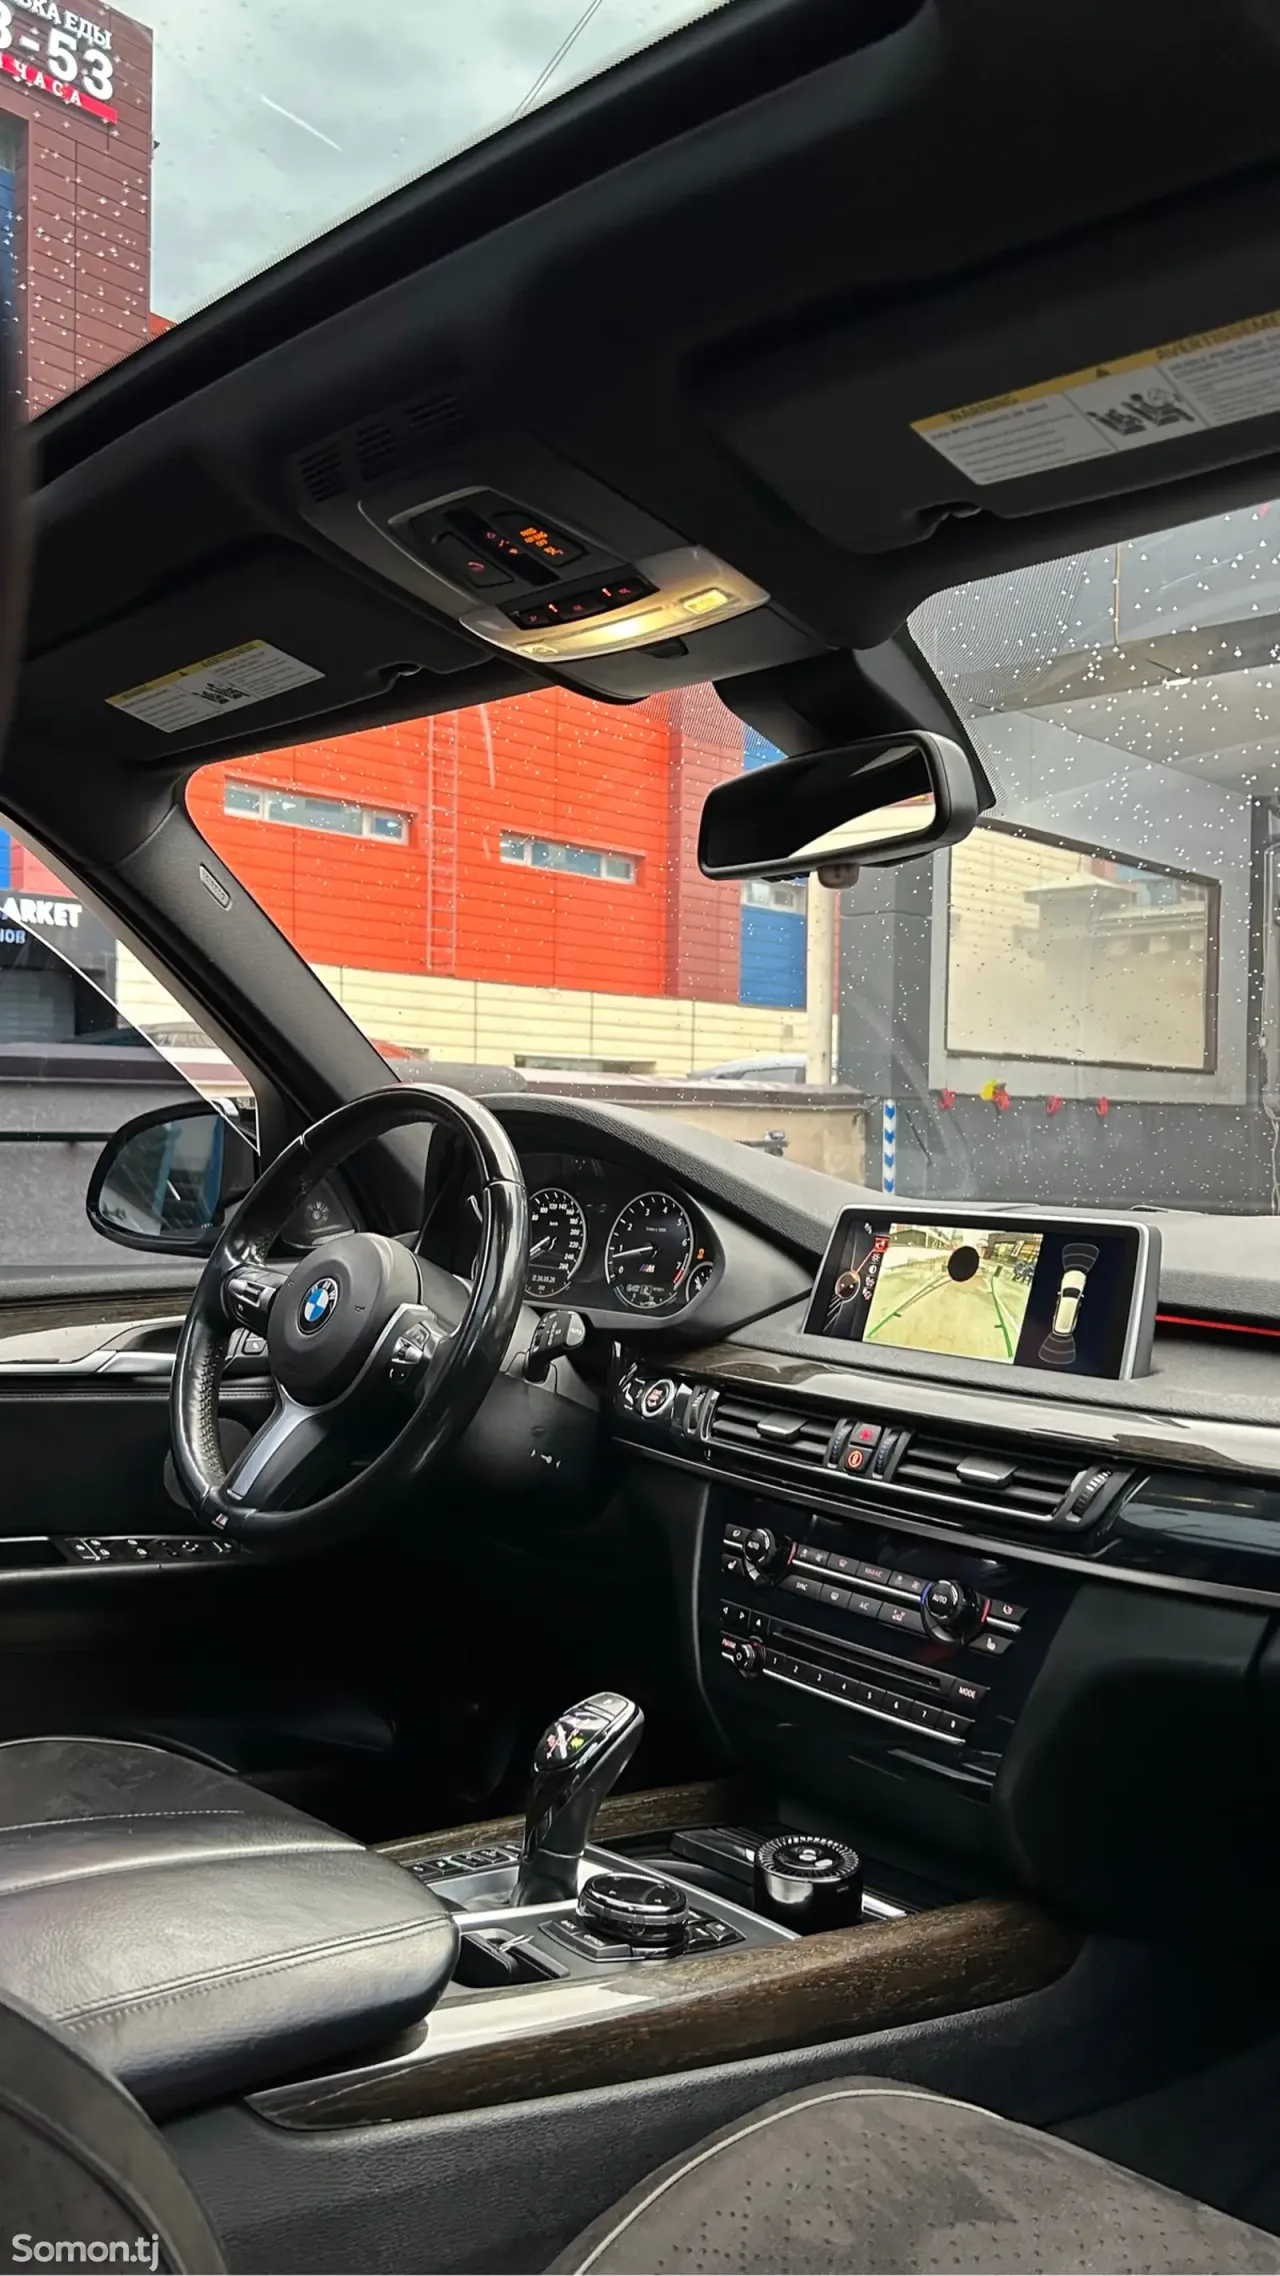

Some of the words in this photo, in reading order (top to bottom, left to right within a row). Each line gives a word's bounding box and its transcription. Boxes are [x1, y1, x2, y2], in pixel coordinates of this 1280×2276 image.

[64, 10, 113, 50] ЕДЫ
[13, 58, 82, 106] ЧАСА
[644, 1208, 651, 1217] 3
[662, 1206, 668, 1214] 4
[627, 1223, 634, 1231] 2
[676, 1218, 683, 1227] 5
[681, 1238, 688, 1247] 6
[676, 1261, 682, 1269] 7
[747, 1540, 760, 1550] AUTO
[932, 1593, 947, 1605] AUTO
[793, 1665, 799, 1673] 2
[817, 1673, 822, 1682] 3
[867, 1691, 872, 1699] 5
[958, 1686, 976, 1699] MODE
[894, 1701, 899, 1709] 6
[922, 1710, 927, 1718] 7
[951, 1720, 956, 1728] 8
